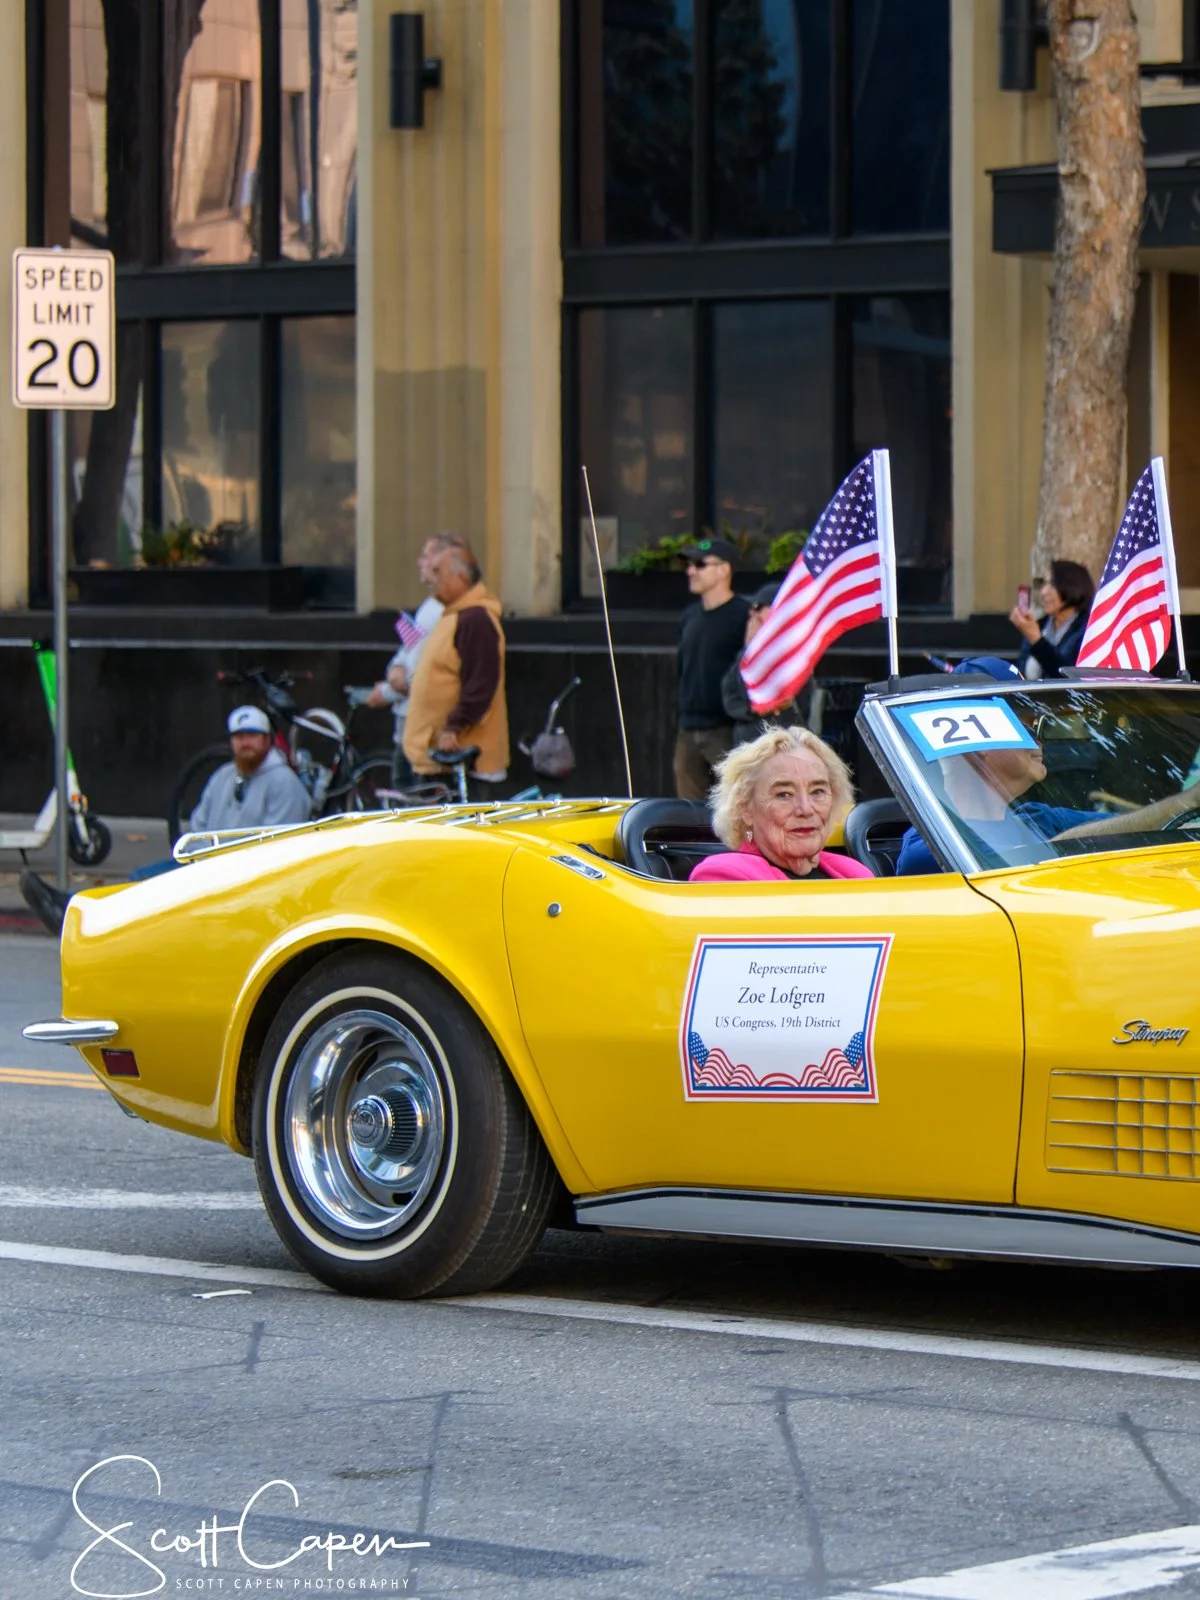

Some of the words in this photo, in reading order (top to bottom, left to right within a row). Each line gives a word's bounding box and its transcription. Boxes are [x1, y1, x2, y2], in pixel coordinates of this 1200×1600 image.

[25, 267, 104, 292] SPEED
[33, 302, 95, 325] LIMIT
[27, 338, 101, 389] 20
[931, 714, 992, 744] 21
[748, 961, 828, 978] Representative
[737, 986, 766, 1004] Zoe
[769, 986, 826, 1009] Lofgren
[715, 1016, 730, 1028] US
[732, 1016, 777, 1031] Congress,
[781, 1016, 802, 1028] 19th
[805, 1016, 841, 1028] District
